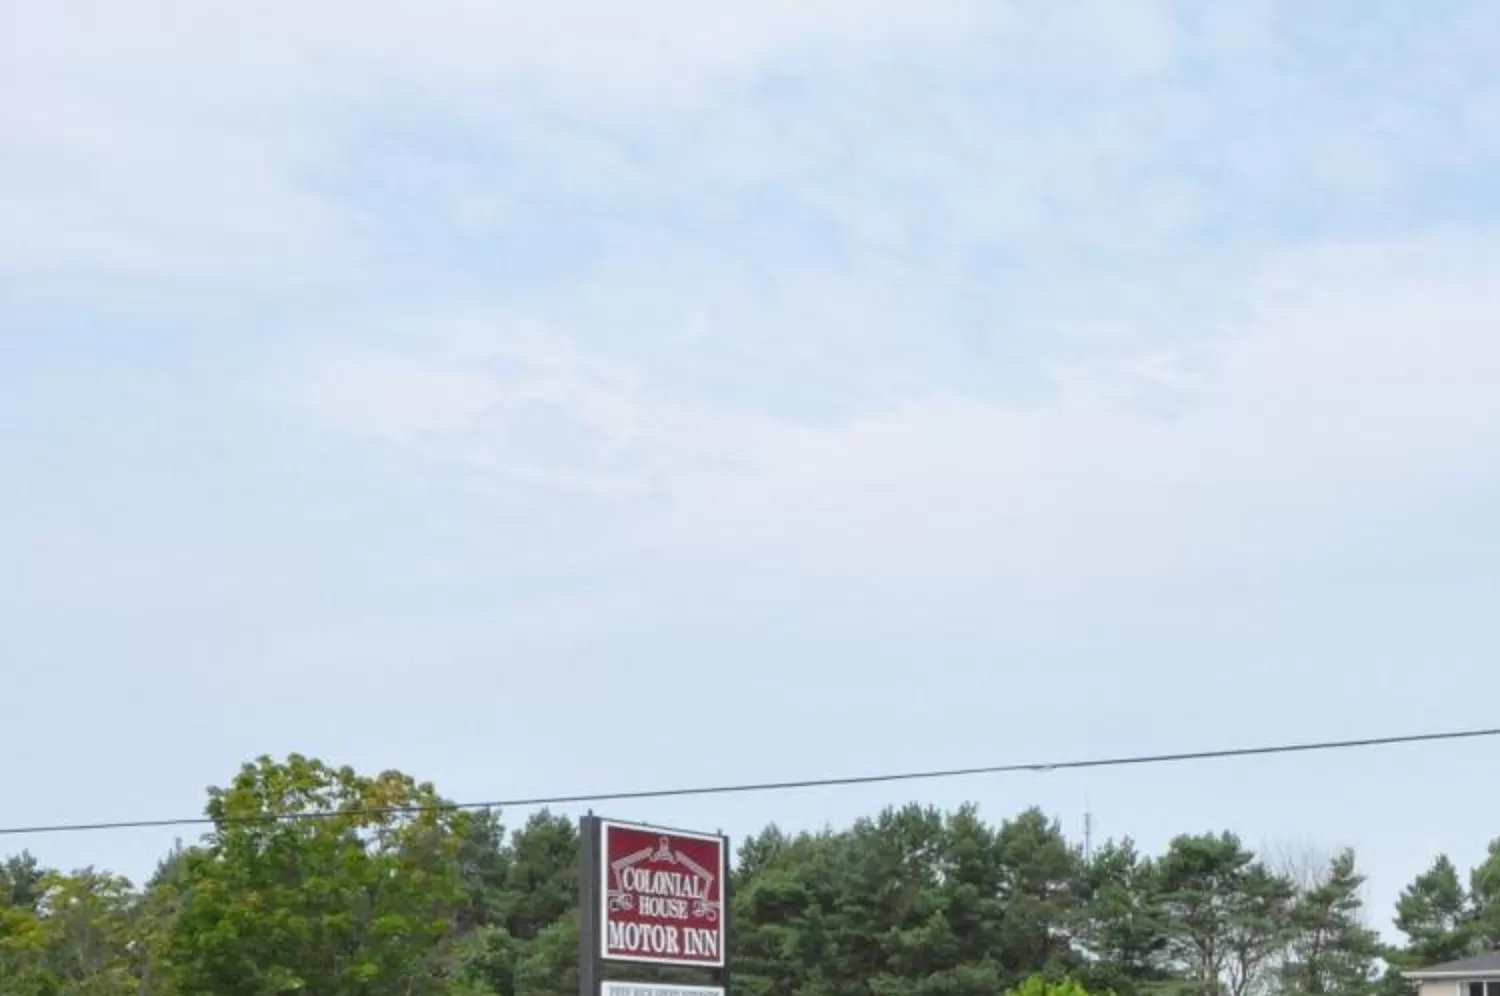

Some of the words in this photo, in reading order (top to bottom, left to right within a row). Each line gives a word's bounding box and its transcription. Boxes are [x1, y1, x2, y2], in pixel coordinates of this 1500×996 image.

[622, 867, 703, 900] COLONIAL
[638, 896, 688, 919] HOUSE
[607, 920, 680, 955] MOTOR
[683, 927, 718, 957] INN
